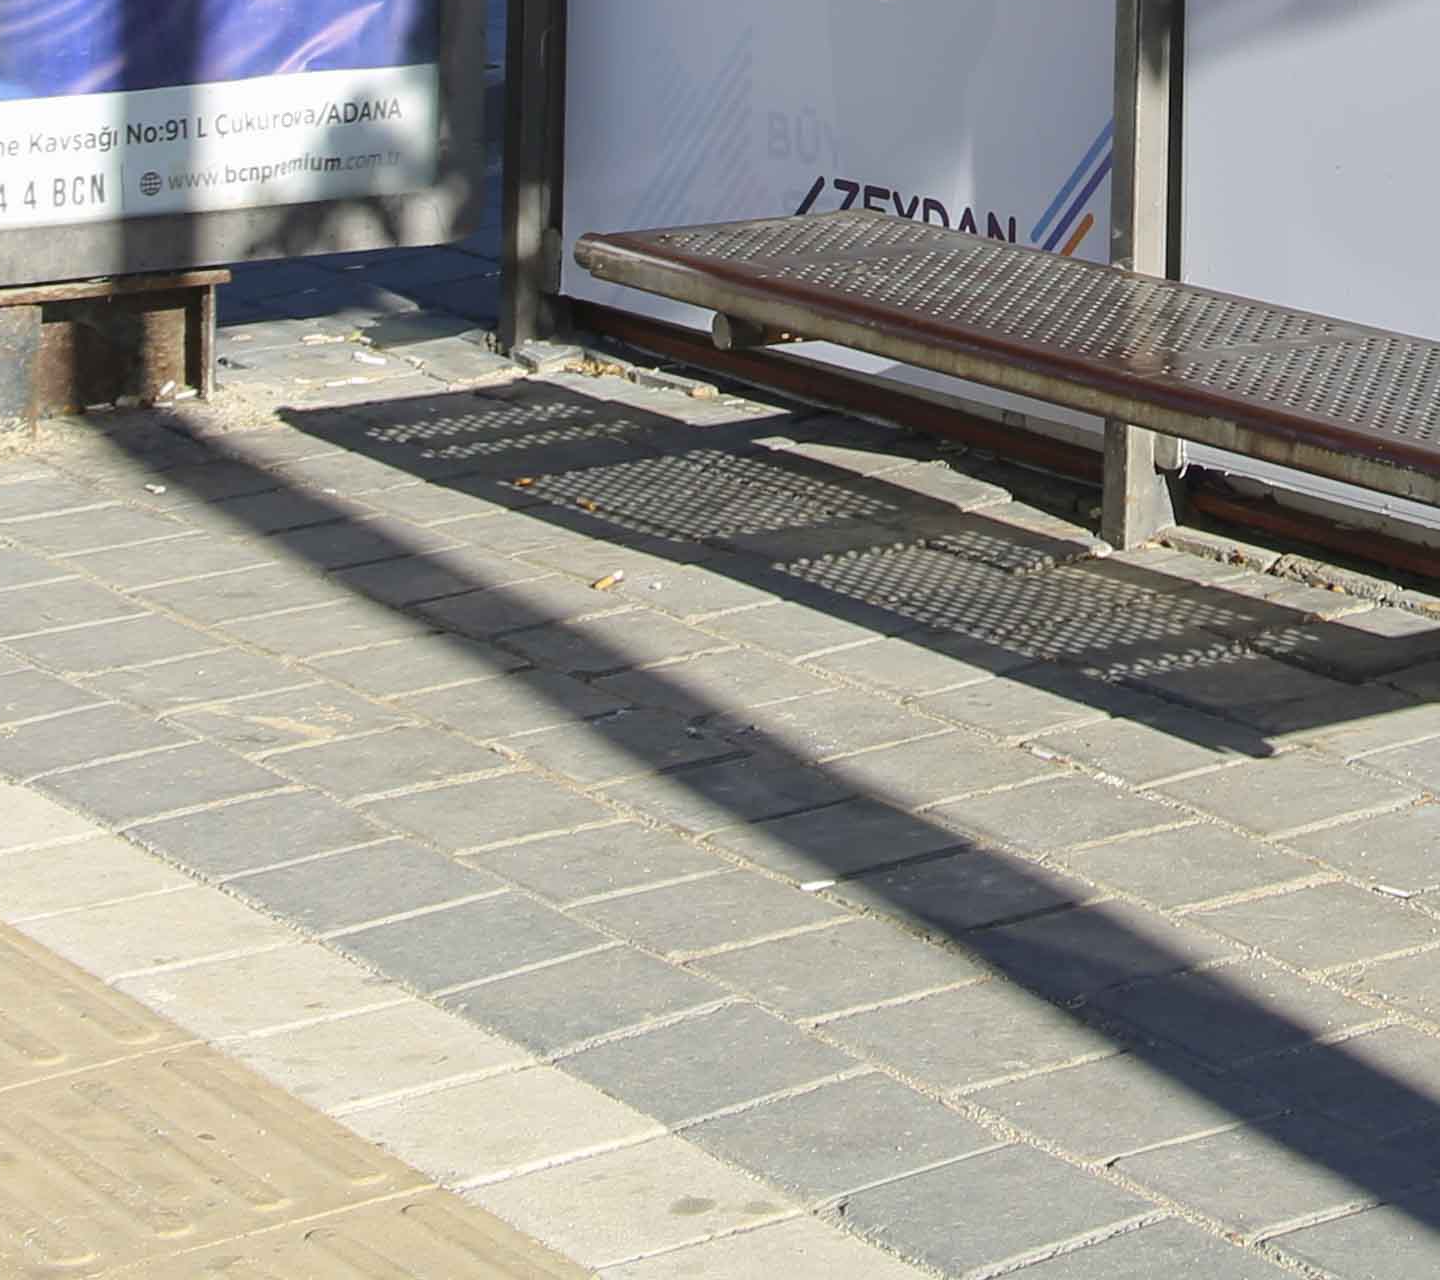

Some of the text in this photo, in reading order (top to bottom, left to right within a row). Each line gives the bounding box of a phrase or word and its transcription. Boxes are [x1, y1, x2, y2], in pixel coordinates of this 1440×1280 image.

[127, 118, 188, 145] No:91
[215, 96, 403, 136] Çukurova/ADANA
[23, 180, 38, 209] 4
[53, 173, 106, 207] BCN
[167, 148, 401, 191] www.bcnpremium.com.tr
[833, 178, 1017, 244] ZEYDAN
